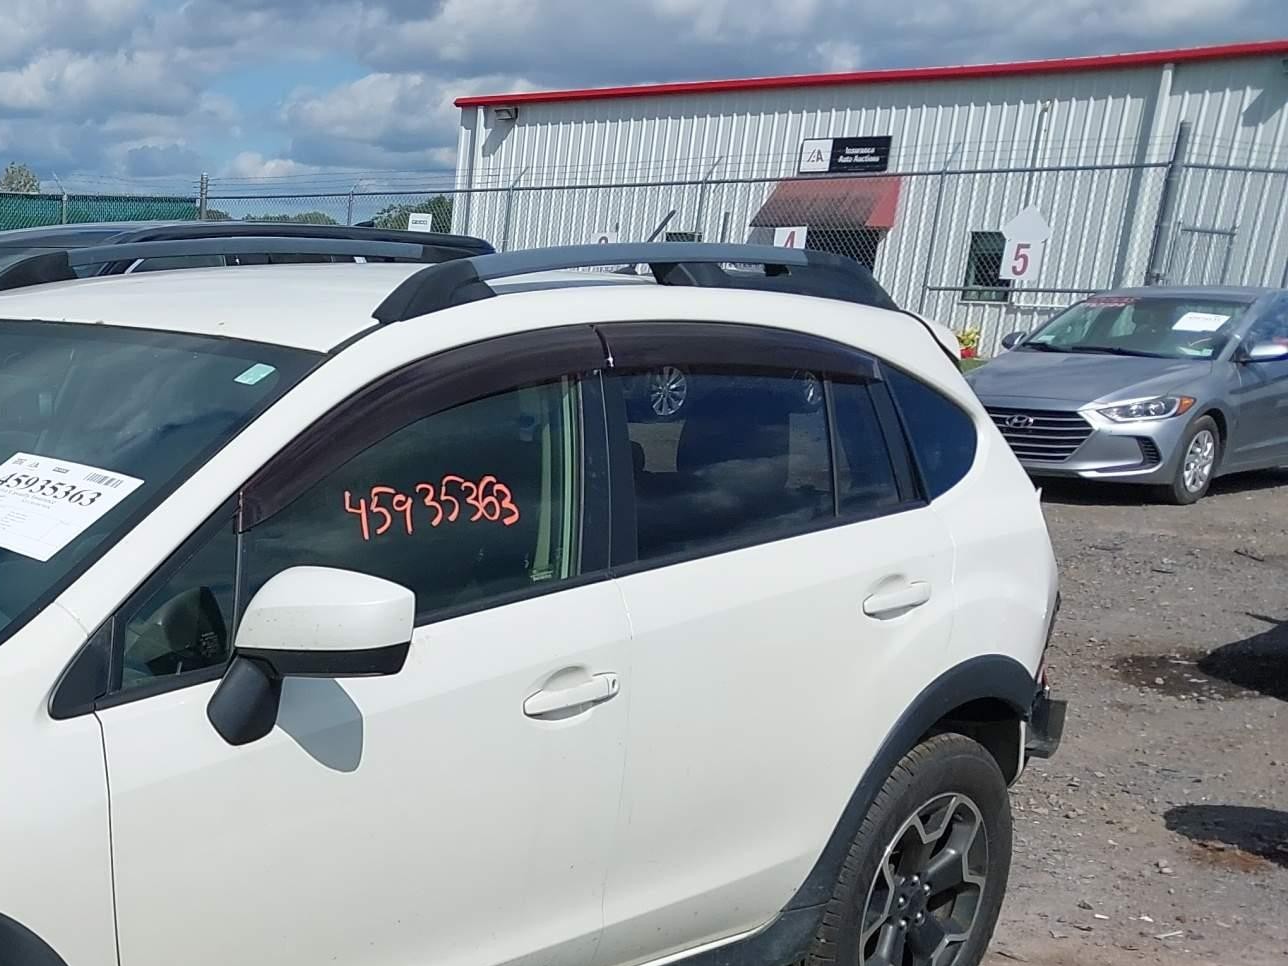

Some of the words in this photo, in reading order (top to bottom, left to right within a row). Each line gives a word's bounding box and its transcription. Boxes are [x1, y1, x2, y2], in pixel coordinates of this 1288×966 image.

[838, 155, 853, 163] Auto
[854, 155, 881, 163] Auctions
[845, 146, 876, 155] Insurance
[1011, 243, 1031, 276] 5
[344, 474, 520, 541] 45935363
